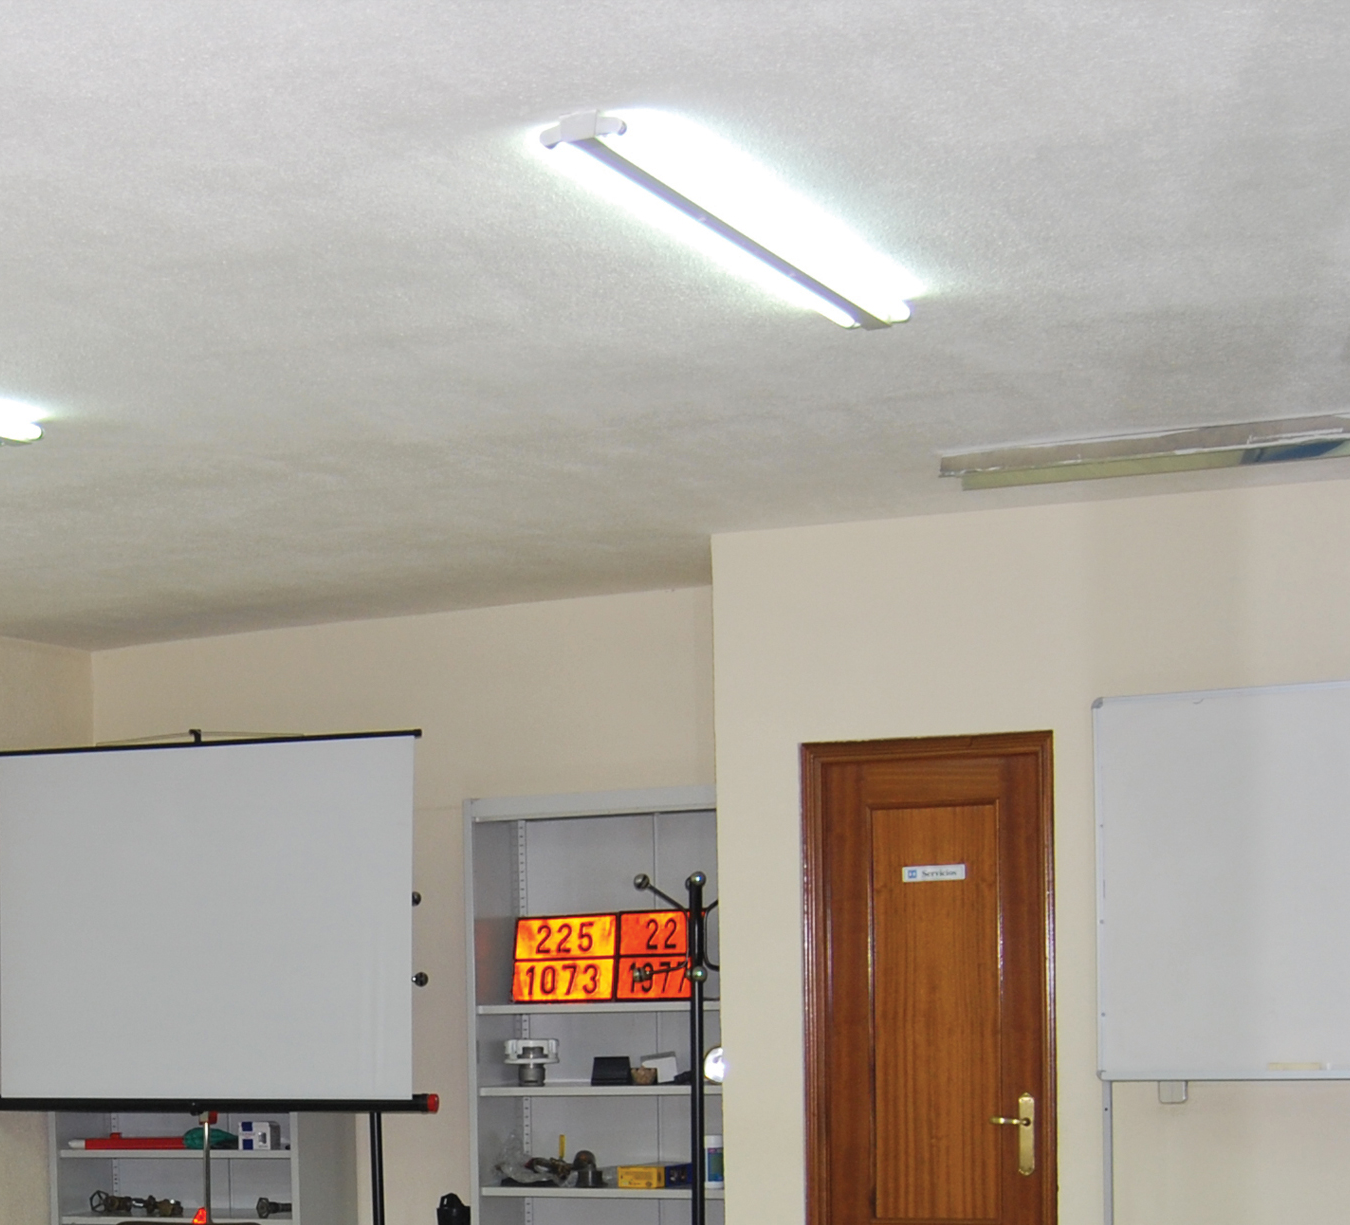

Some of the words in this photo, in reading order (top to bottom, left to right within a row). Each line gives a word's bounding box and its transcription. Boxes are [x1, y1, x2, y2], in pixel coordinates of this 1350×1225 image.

[535, 921, 595, 955] 225
[645, 917, 678, 950] 22
[525, 963, 599, 996] 1073
